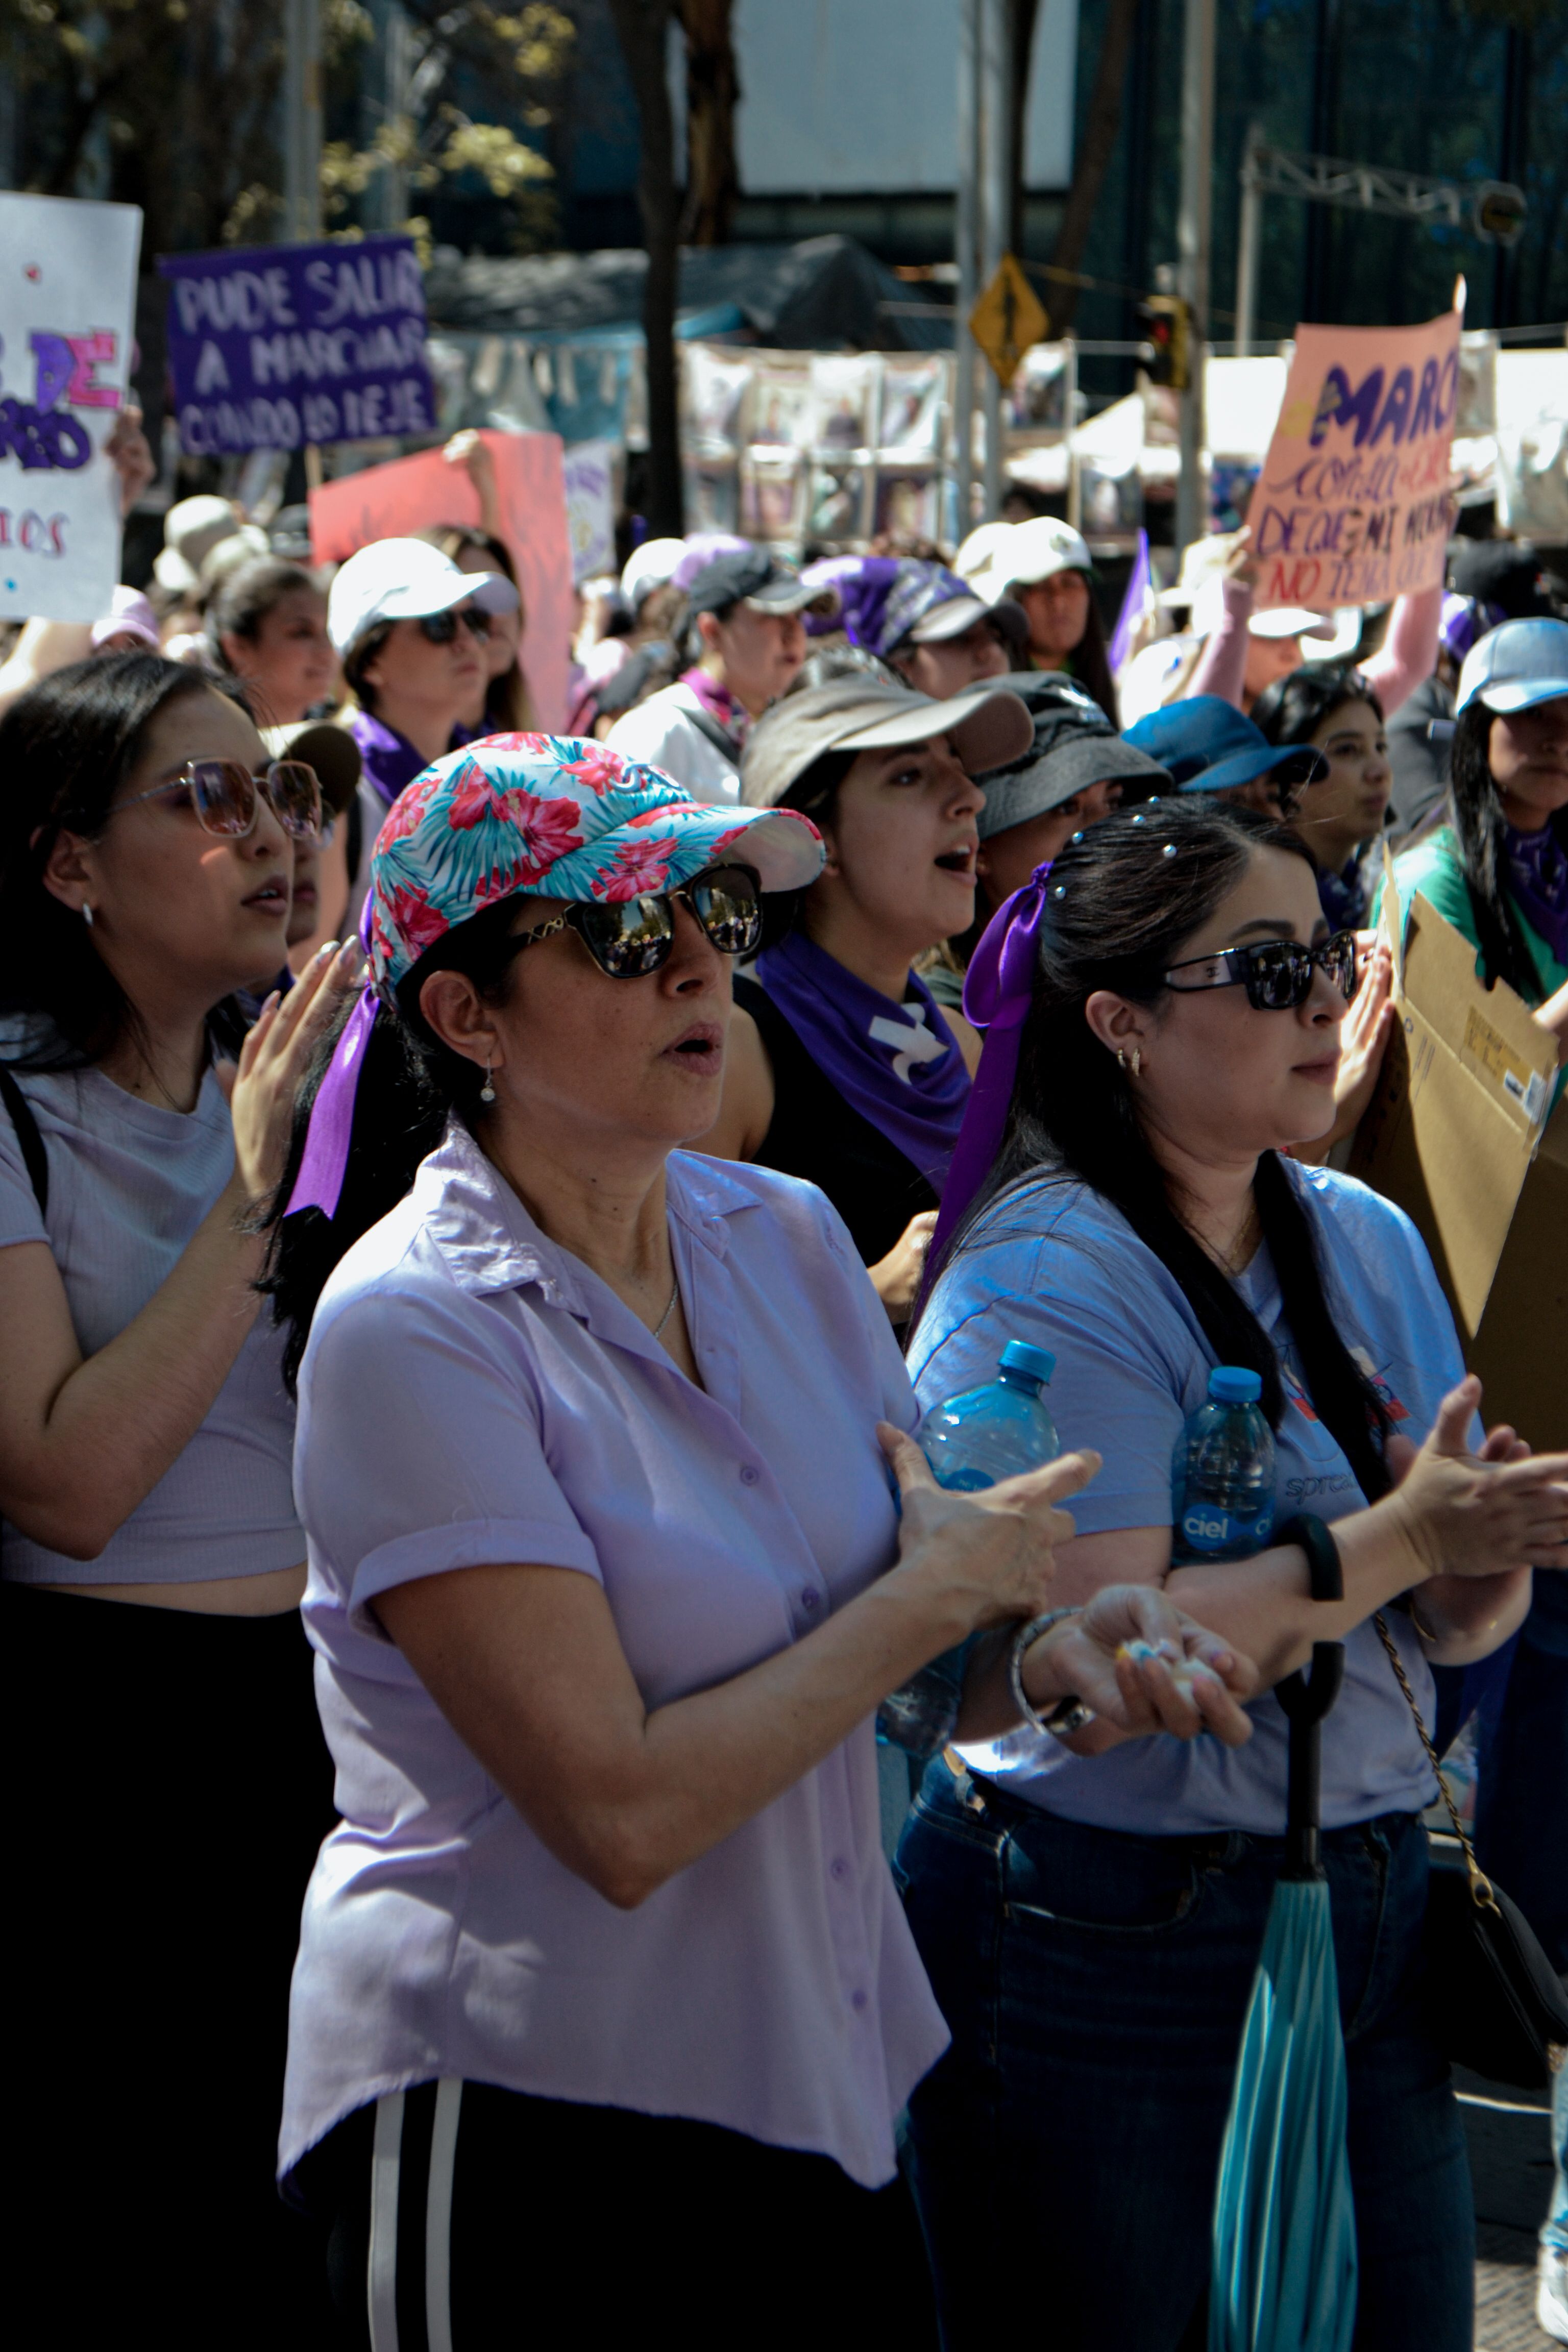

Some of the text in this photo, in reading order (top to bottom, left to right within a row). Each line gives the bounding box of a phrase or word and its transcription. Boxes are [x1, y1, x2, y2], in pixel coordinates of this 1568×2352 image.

[175, 267, 297, 334] PUDE
[194, 339, 230, 396] A
[1264, 558, 1321, 602] NO
[1184, 1512, 1229, 1539] ciel
